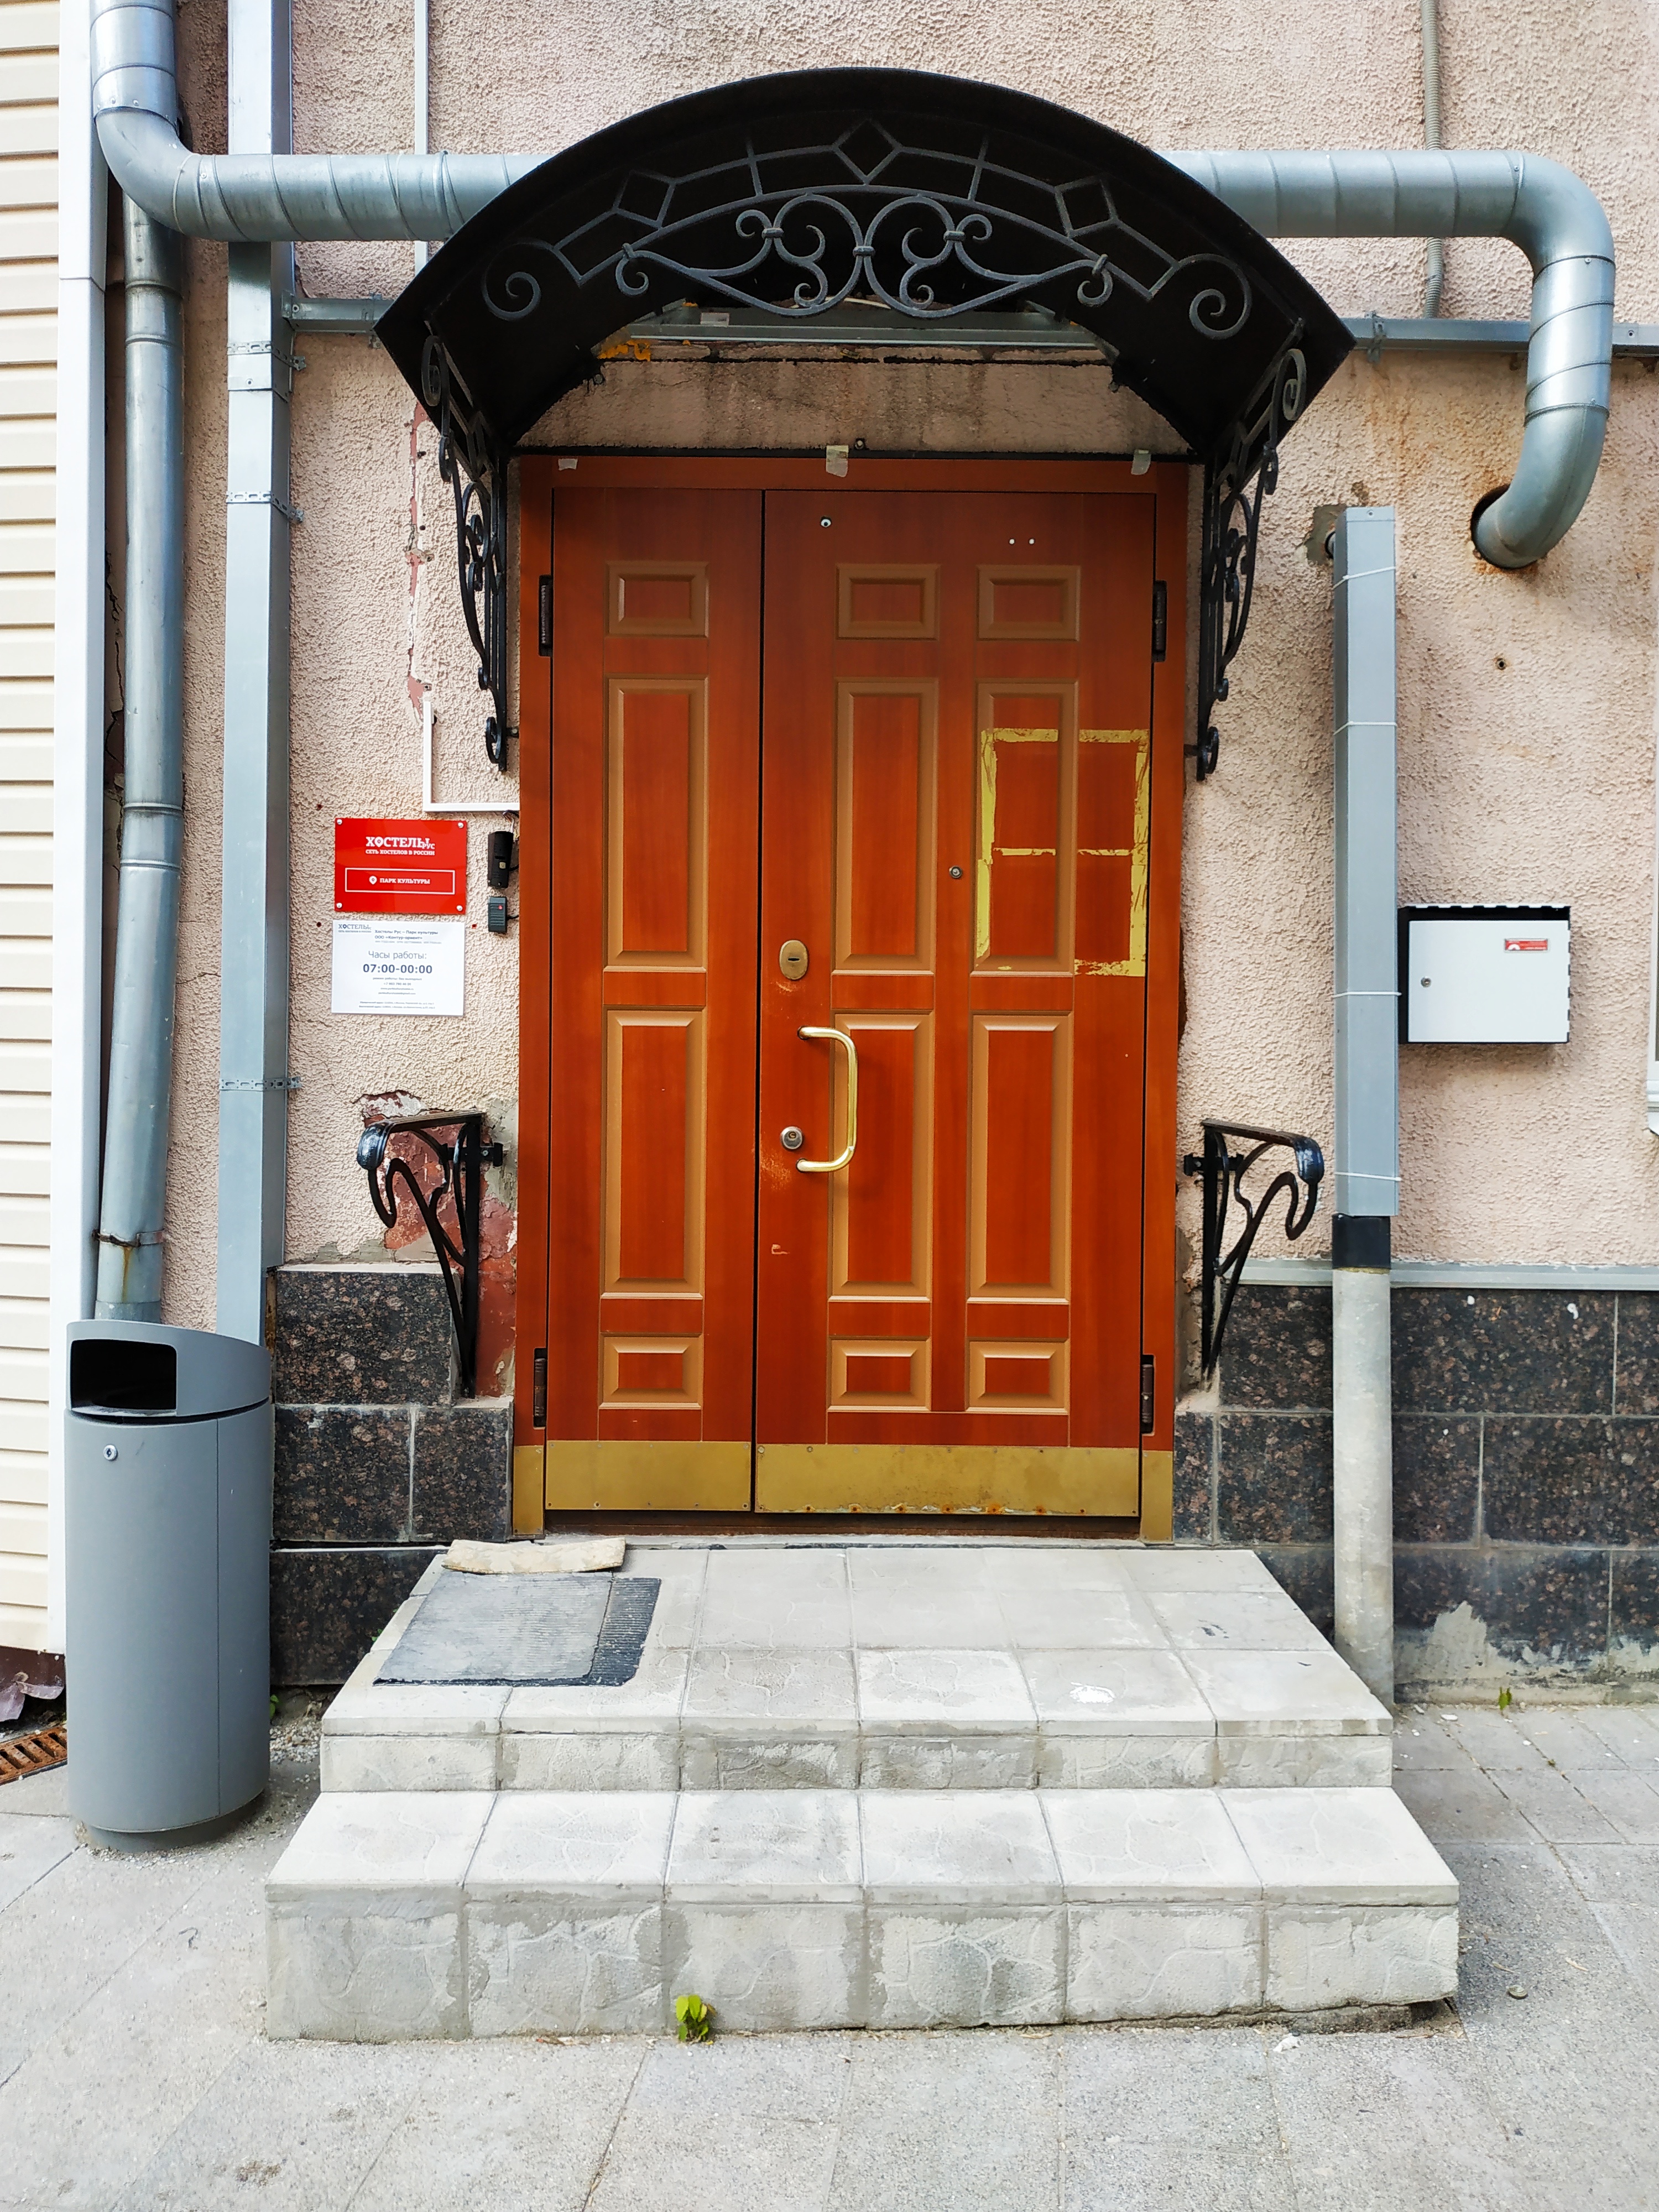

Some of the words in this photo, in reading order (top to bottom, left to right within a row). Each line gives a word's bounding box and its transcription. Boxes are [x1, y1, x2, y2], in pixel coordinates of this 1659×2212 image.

[366, 836, 430, 848] ХОСТЕЛЫ
[393, 951, 427, 960] работы:
[363, 964, 432, 974] 07:00-00:00
